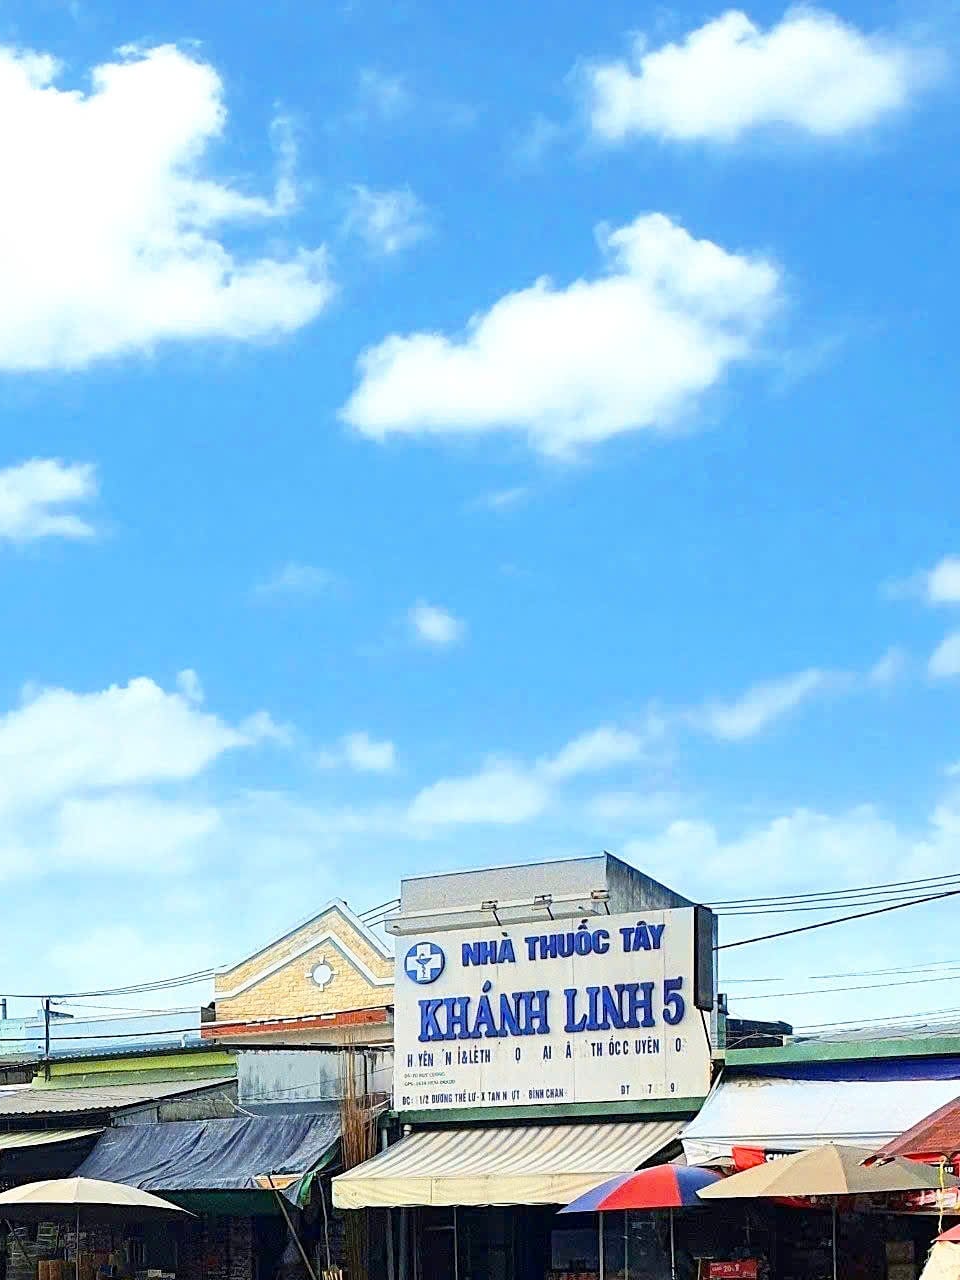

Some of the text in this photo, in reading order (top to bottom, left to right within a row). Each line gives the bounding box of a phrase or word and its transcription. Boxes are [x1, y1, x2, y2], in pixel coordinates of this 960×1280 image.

[461, 919, 666, 967] NHÀ THUỐC TÂY
[418, 976, 685, 1042] KHÁNH LINH 5
